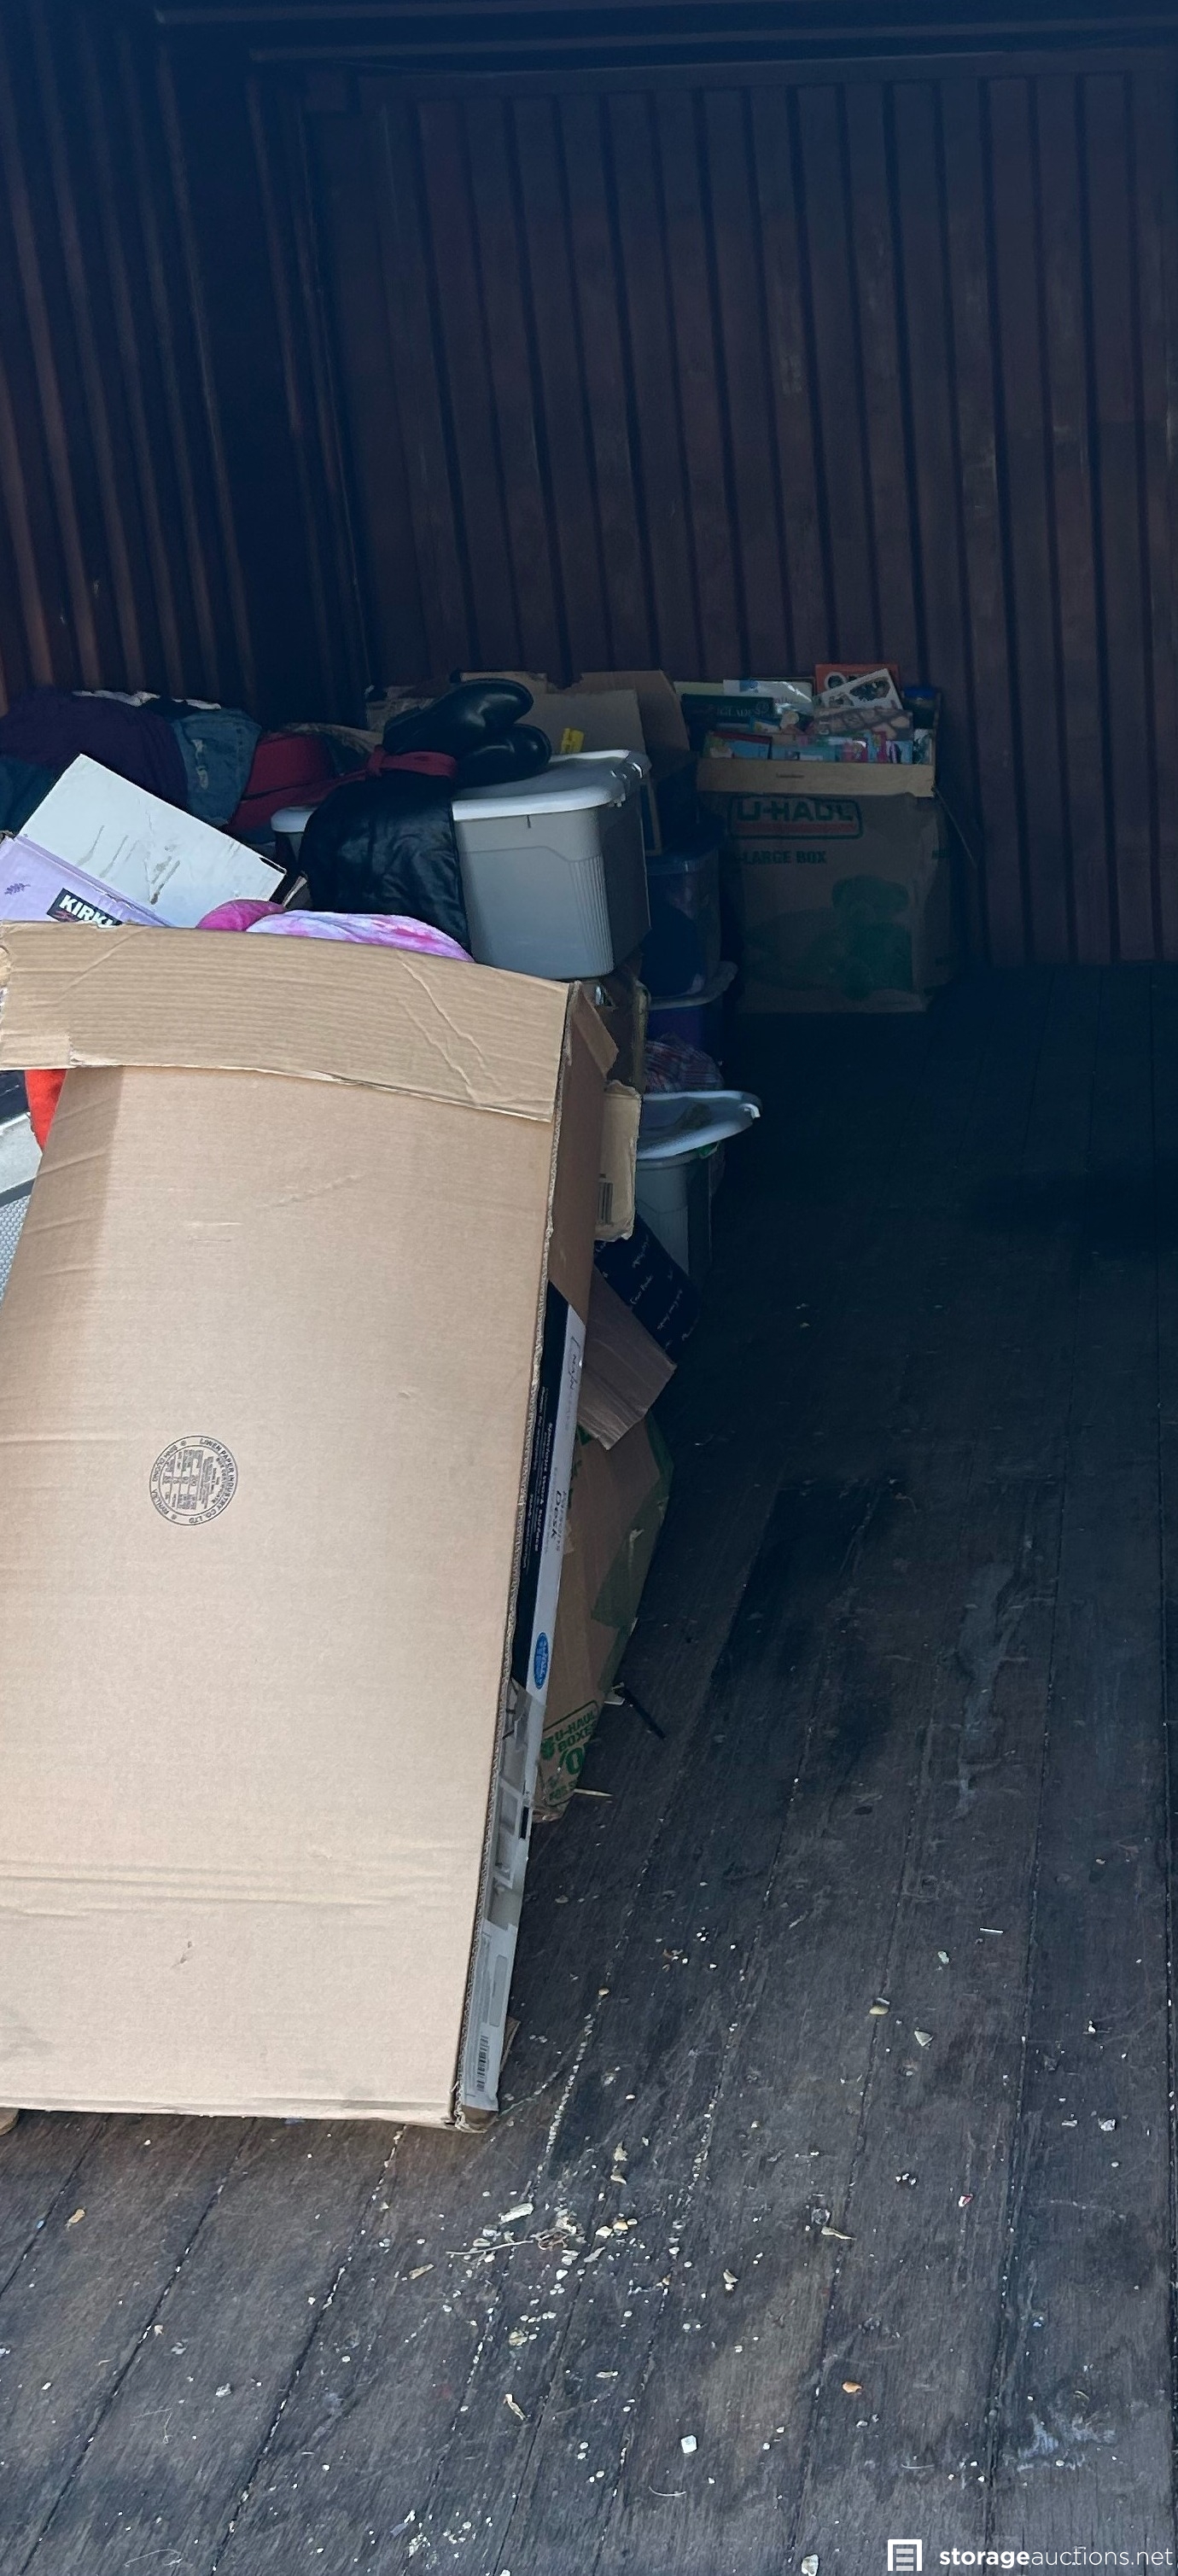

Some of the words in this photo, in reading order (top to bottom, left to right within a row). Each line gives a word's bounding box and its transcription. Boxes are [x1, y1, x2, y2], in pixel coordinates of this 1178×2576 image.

[736, 800, 853, 821] U-HAUL
[796, 850, 827, 865] BOX
[219, 1449, 235, 1474] PAPER
[217, 1475, 235, 1510] INDUSTRY
[189, 1515, 203, 1524] LTD
